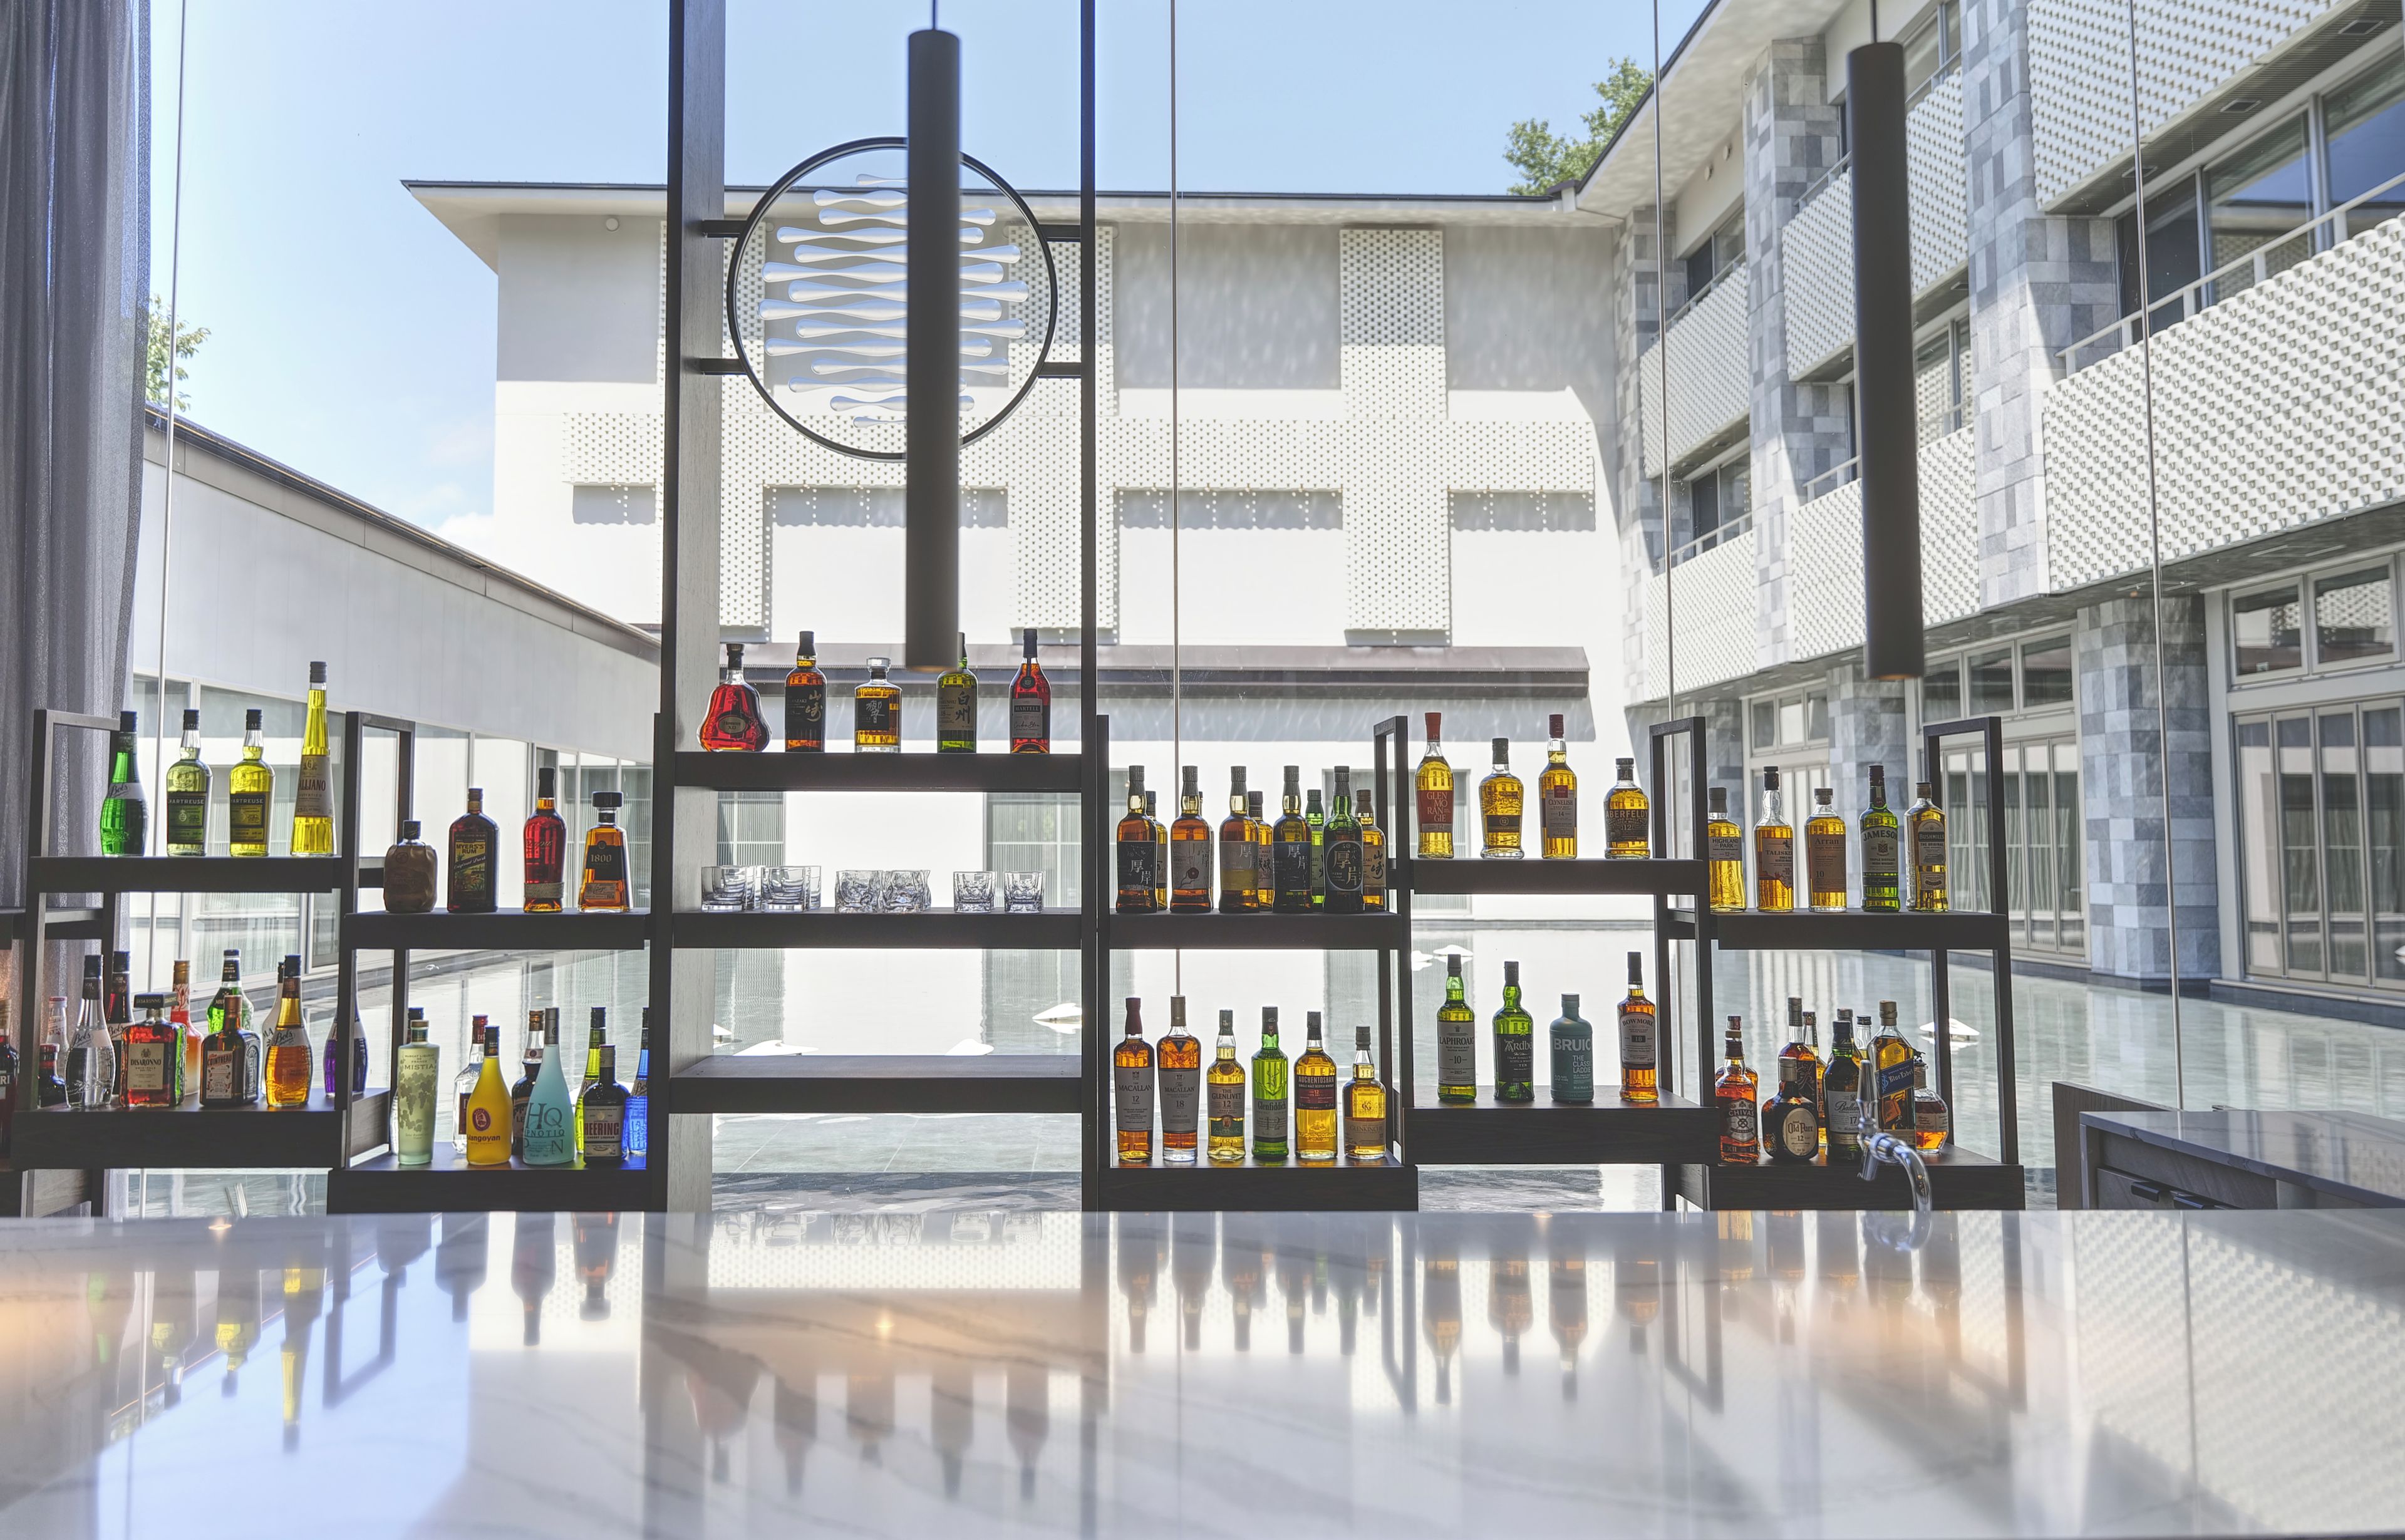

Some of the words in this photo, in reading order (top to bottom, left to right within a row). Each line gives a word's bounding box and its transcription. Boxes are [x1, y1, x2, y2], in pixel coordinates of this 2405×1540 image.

[955, 691, 970, 724] 白州
[108, 783, 128, 797] Bols
[1427, 792, 1447, 800] GLEN
[1605, 810, 1648, 819] ABERFELDY
[590, 854, 611, 862] 1800
[1129, 859, 1152, 885] 厚岸
[1621, 1018, 1653, 1027] BOWMORE
[75, 1030, 91, 1045] Bols
[276, 1030, 292, 1045] Bols
[209, 1053, 232, 1066] COINTREAU
[1454, 1055, 1461, 1064] 10
[1888, 1074, 1900, 1083] Blue
[1901, 1068, 1914, 1078] Label
[525, 1103, 563, 1130] HQ
[1849, 1116, 1857, 1124] 17
[584, 1122, 619, 1136] HEERING
[1266, 1117, 1280, 1130] 12
[1787, 1123, 1799, 1134] Old
[526, 1129, 565, 1137] PNOTIQ
